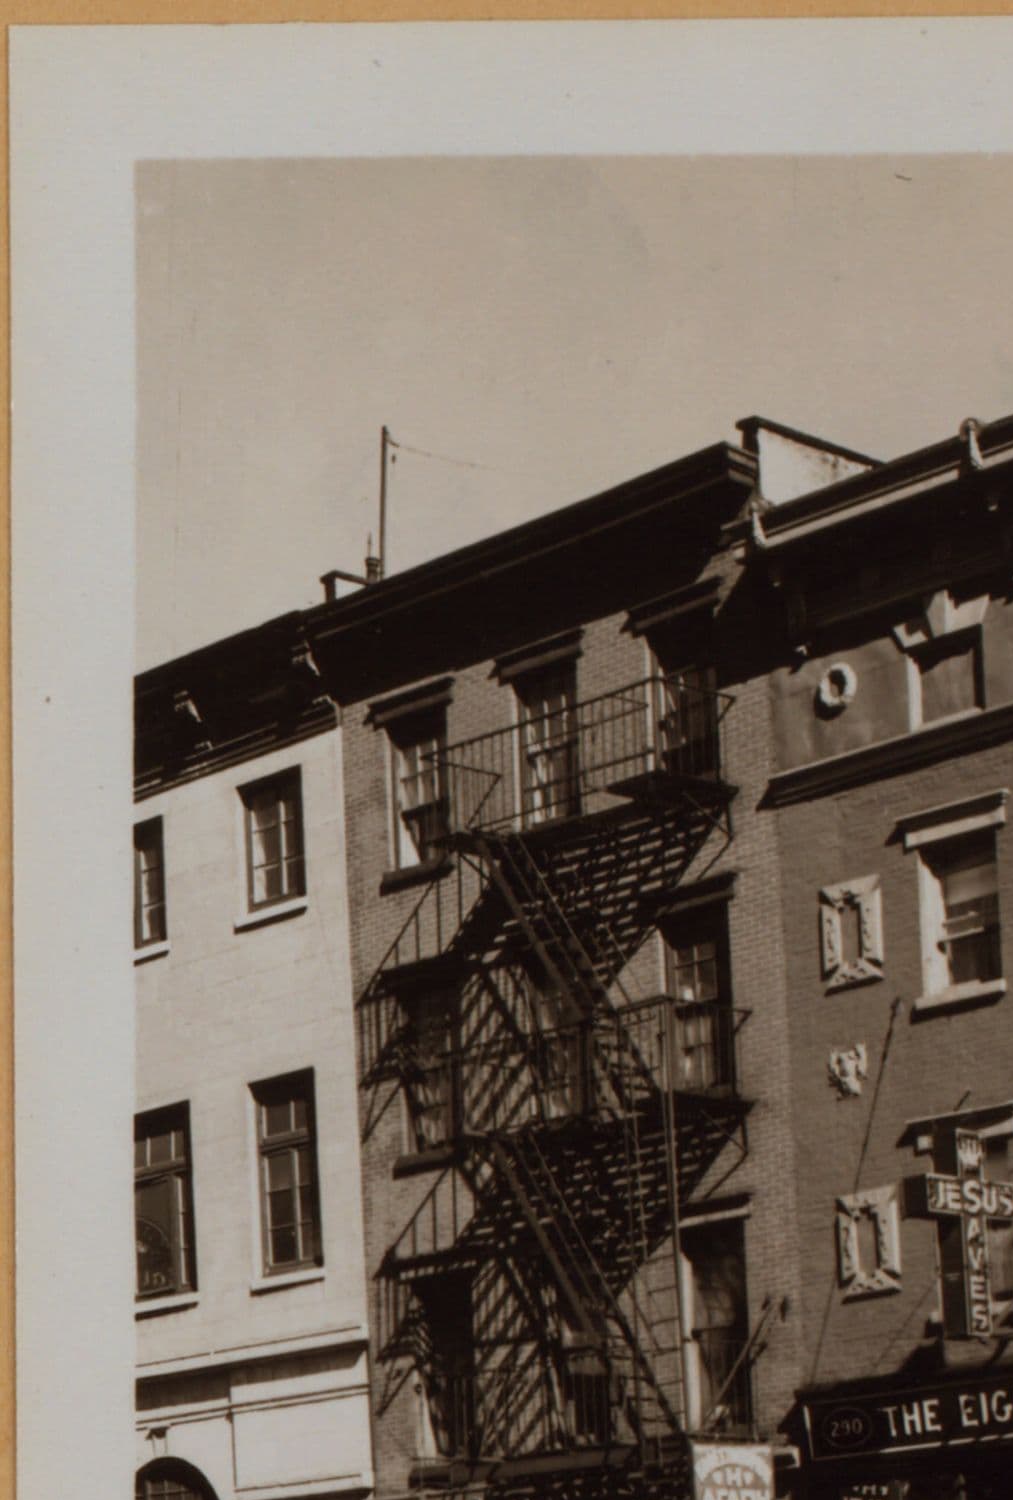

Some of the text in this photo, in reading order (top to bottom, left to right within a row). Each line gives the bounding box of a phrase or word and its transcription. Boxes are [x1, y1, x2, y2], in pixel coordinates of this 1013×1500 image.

[933, 1180, 1013, 1216] JESUS
[830, 1416, 864, 1438] 290
[879, 1397, 943, 1438] THE
